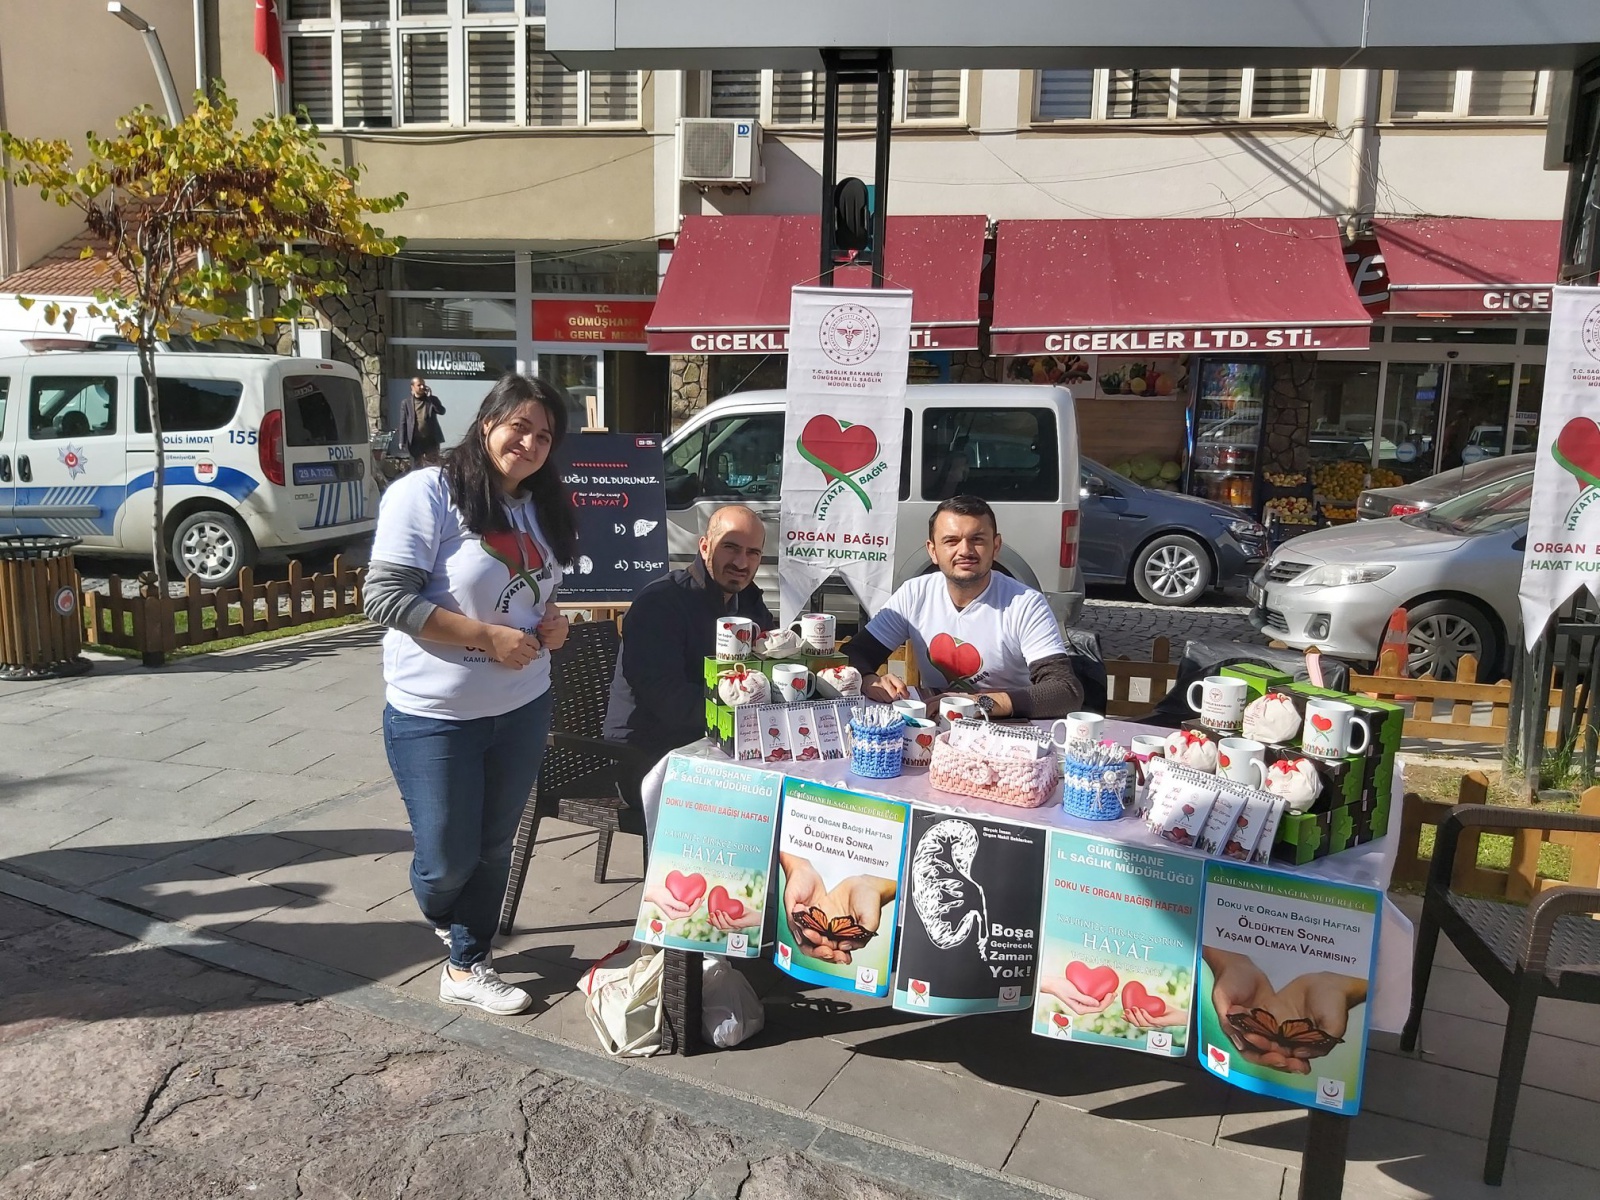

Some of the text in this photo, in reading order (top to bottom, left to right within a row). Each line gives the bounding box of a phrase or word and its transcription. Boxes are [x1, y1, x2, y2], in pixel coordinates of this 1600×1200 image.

[595, 304, 611, 313] T.C.
[1483, 292, 1550, 309] CiCE
[570, 331, 605, 340] GENEL
[1194, 330, 1257, 348] LTD.
[163, 430, 257, 445] OLİS İMDAT 155
[592, 476, 660, 485] DOLDURUNUZ.
[818, 461, 888, 520] HAYATA BAĞIŞ
[614, 523, 626, 535] b)
[787, 531, 889, 547] ORGAN BAĞIŞI
[786, 547, 887, 561] HAYAT KURTARIR
[1534, 543, 1586, 554] ORGAN
[614, 560, 664, 572] d) Diğer
[1531, 560, 1572, 570] HAYAT
[501, 581, 526, 613] HAYATA
[696, 765, 752, 782] GÜMÜŞHANE
[681, 774, 712, 786] SAĞLIK
[715, 778, 773, 797] MÜDÜRLÜĞÜ
[666, 797, 683, 807] DOKU
[695, 802, 716, 814] ORGAN
[741, 812, 770, 823] HAFTASI
[804, 824, 873, 851] ÖLDÜKTEN SONRA
[865, 828, 893, 840] HAFTASI
[682, 844, 737, 866] HAYAT
[789, 834, 889, 867] YAŞAM OLMAYA VARMISIN?
[1087, 844, 1164, 867] GÜMÜŞHANE
[1058, 847, 1194, 886] İL SAĞLIK MÜDÜRLÜĞÜ
[1055, 878, 1193, 915] DOKU VE ORGAN BAĞIŞI HAFTASI
[1277, 887, 1309, 900] SAĞLIK
[1217, 897, 1242, 910] DOKU
[1256, 906, 1288, 919] ORGAN
[1290, 912, 1321, 926] BAĞIŞI
[1323, 918, 1360, 933] HAFTASI
[992, 923, 1034, 941] Boşa
[1238, 915, 1335, 946] ÖLDÜKTEN SONRA
[990, 940, 1033, 949] Geçirecek
[1083, 932, 1153, 961] HAYAT
[1149, 936, 1183, 948] SORUN
[1216, 927, 1356, 965] YAŞAM OLMAYA VARMISIN?
[990, 951, 1033, 960] Zaman
[989, 966, 1031, 978] Yok!
